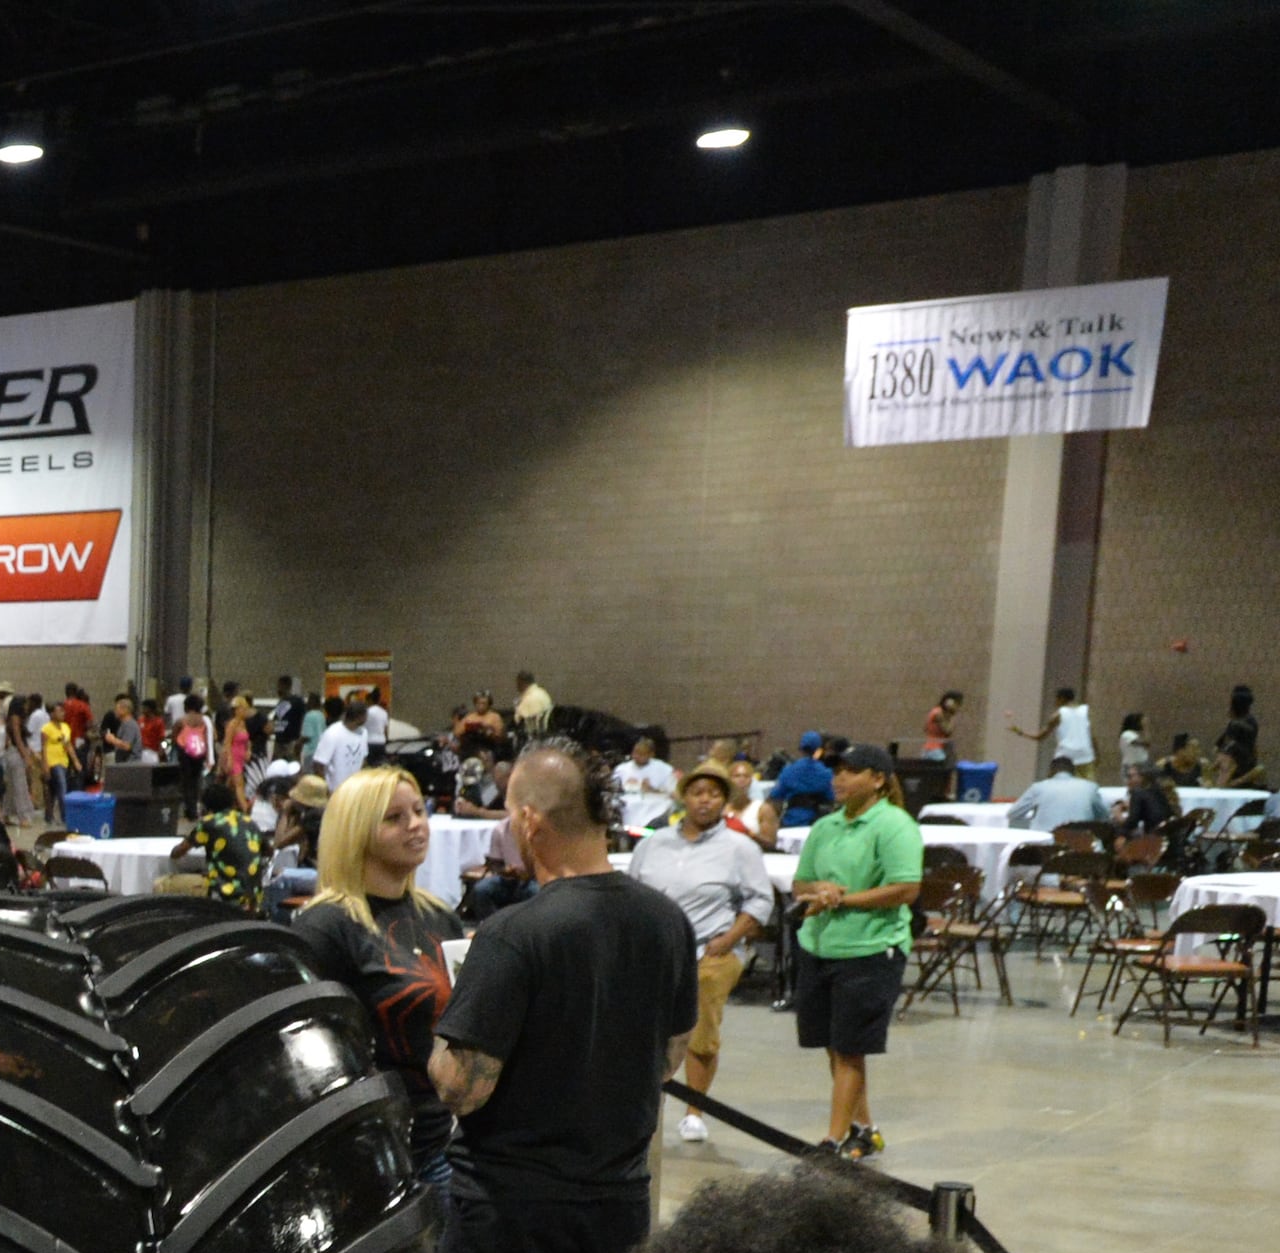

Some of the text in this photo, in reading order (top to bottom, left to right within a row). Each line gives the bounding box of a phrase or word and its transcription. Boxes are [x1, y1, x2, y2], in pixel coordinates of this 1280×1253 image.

[949, 312, 1124, 346] News & Talk
[868, 348, 935, 400] 1380
[946, 340, 1136, 390] WAOK
